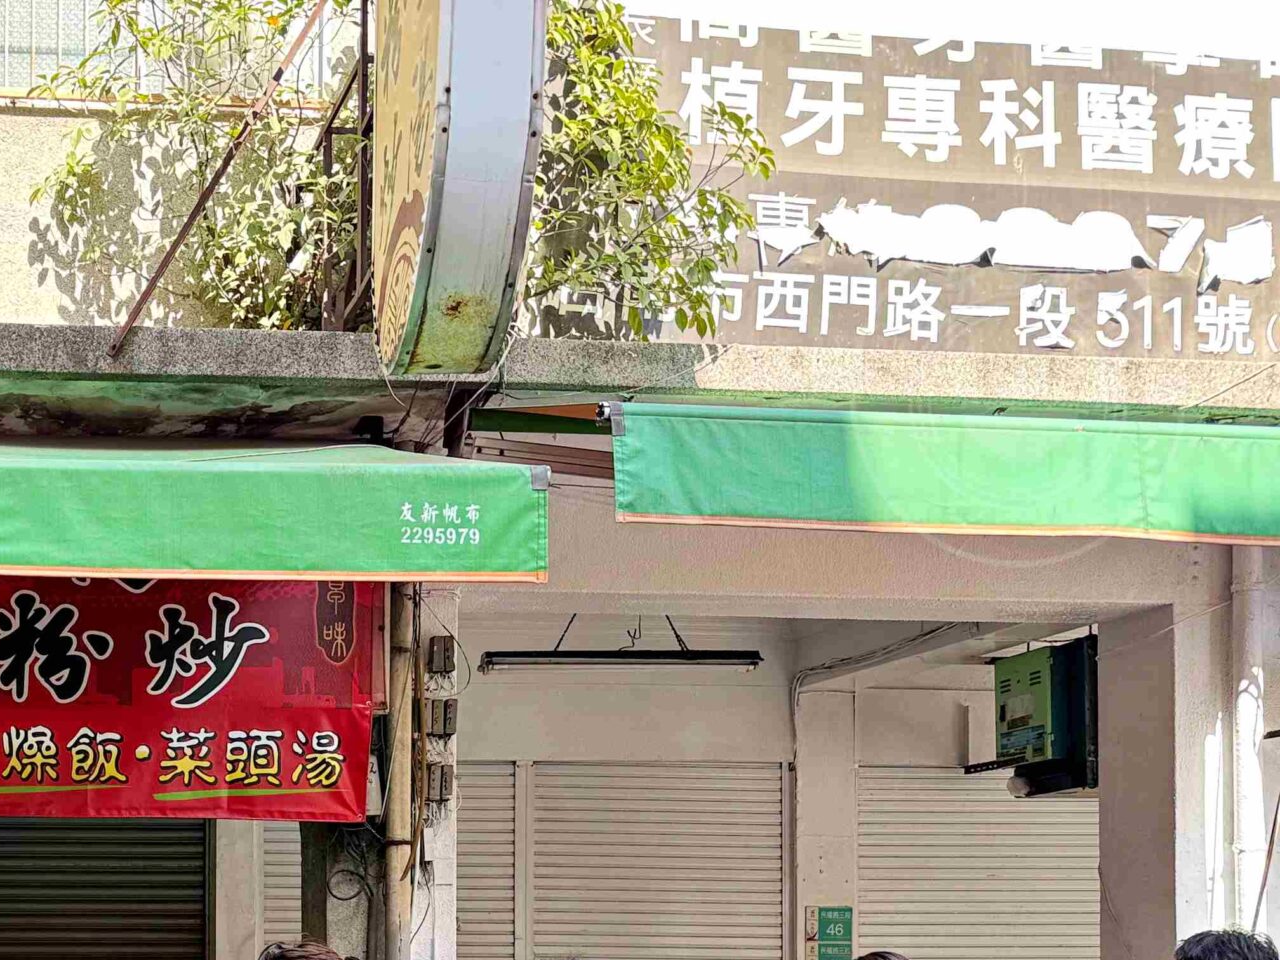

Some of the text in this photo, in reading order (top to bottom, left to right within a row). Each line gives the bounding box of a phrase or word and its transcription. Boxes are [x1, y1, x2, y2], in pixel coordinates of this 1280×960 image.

[679, 56, 1280, 180] 植牙專科醫療
[400, 501, 481, 525] 友新帆布
[401, 526, 481, 545] 2295979
[826, 923, 844, 936] 46
